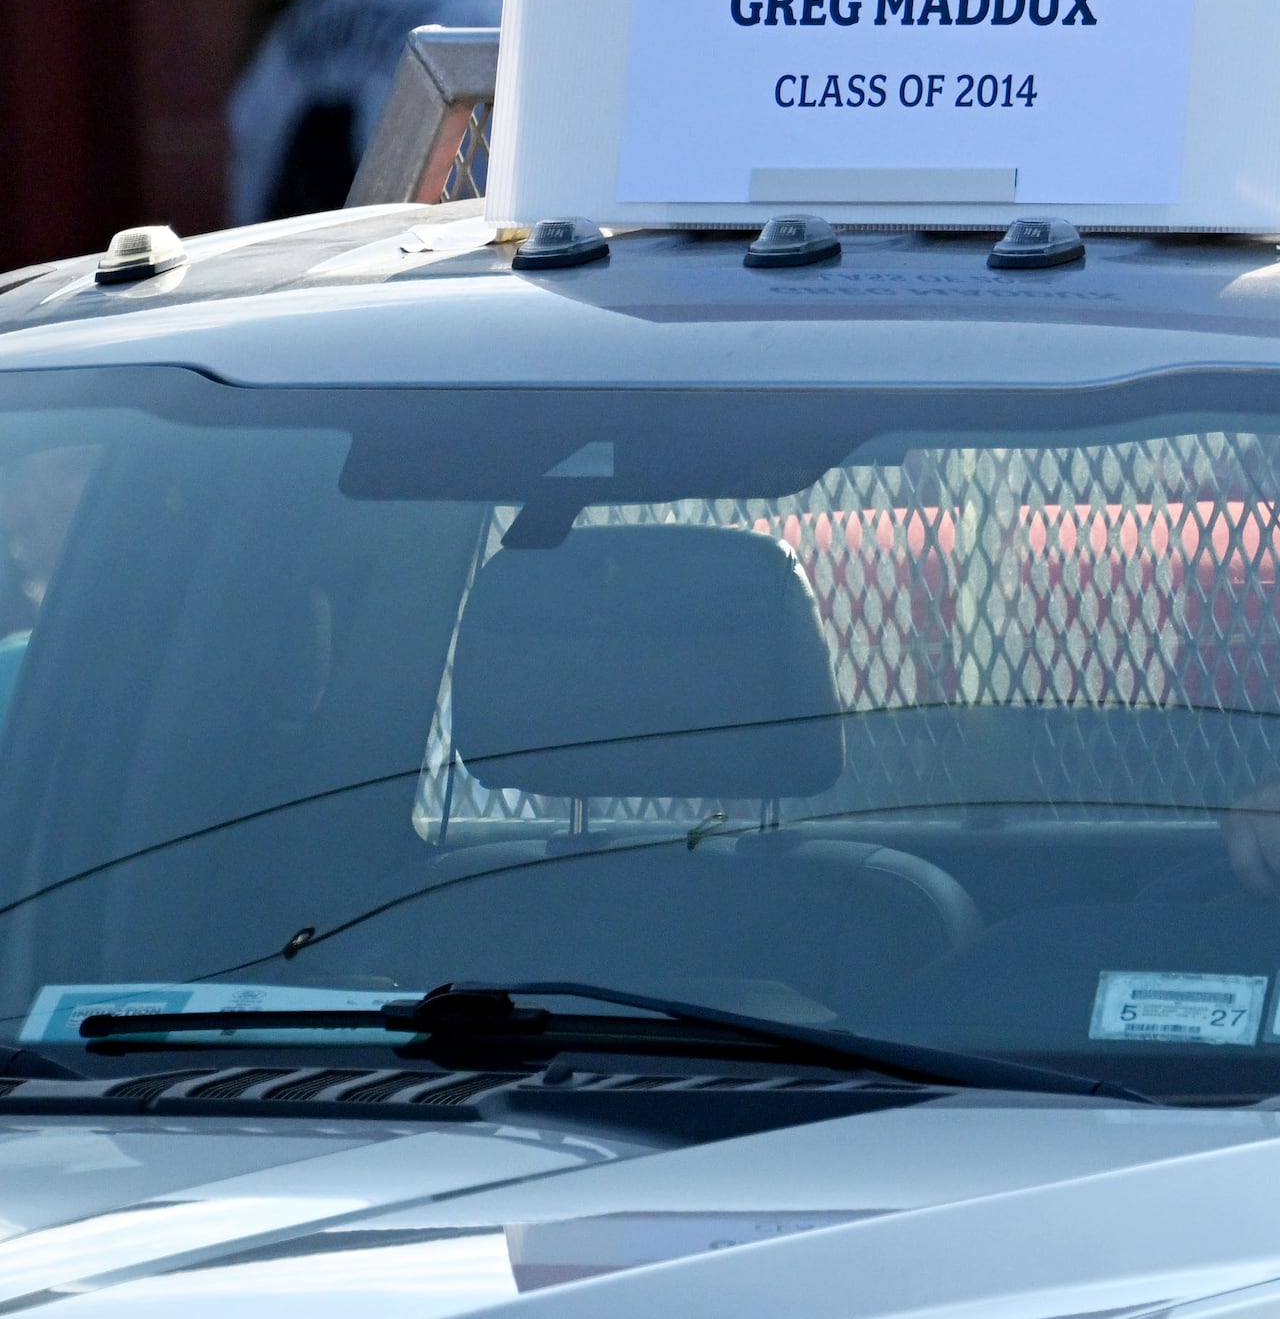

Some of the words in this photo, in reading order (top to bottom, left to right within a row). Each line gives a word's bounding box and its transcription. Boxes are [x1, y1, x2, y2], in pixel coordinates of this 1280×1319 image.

[774, 74, 888, 108] CLASS
[898, 74, 945, 108] OF
[954, 74, 1039, 108] 2014
[1120, 1004, 1138, 1022] 5
[1209, 1009, 1249, 1027] 27
